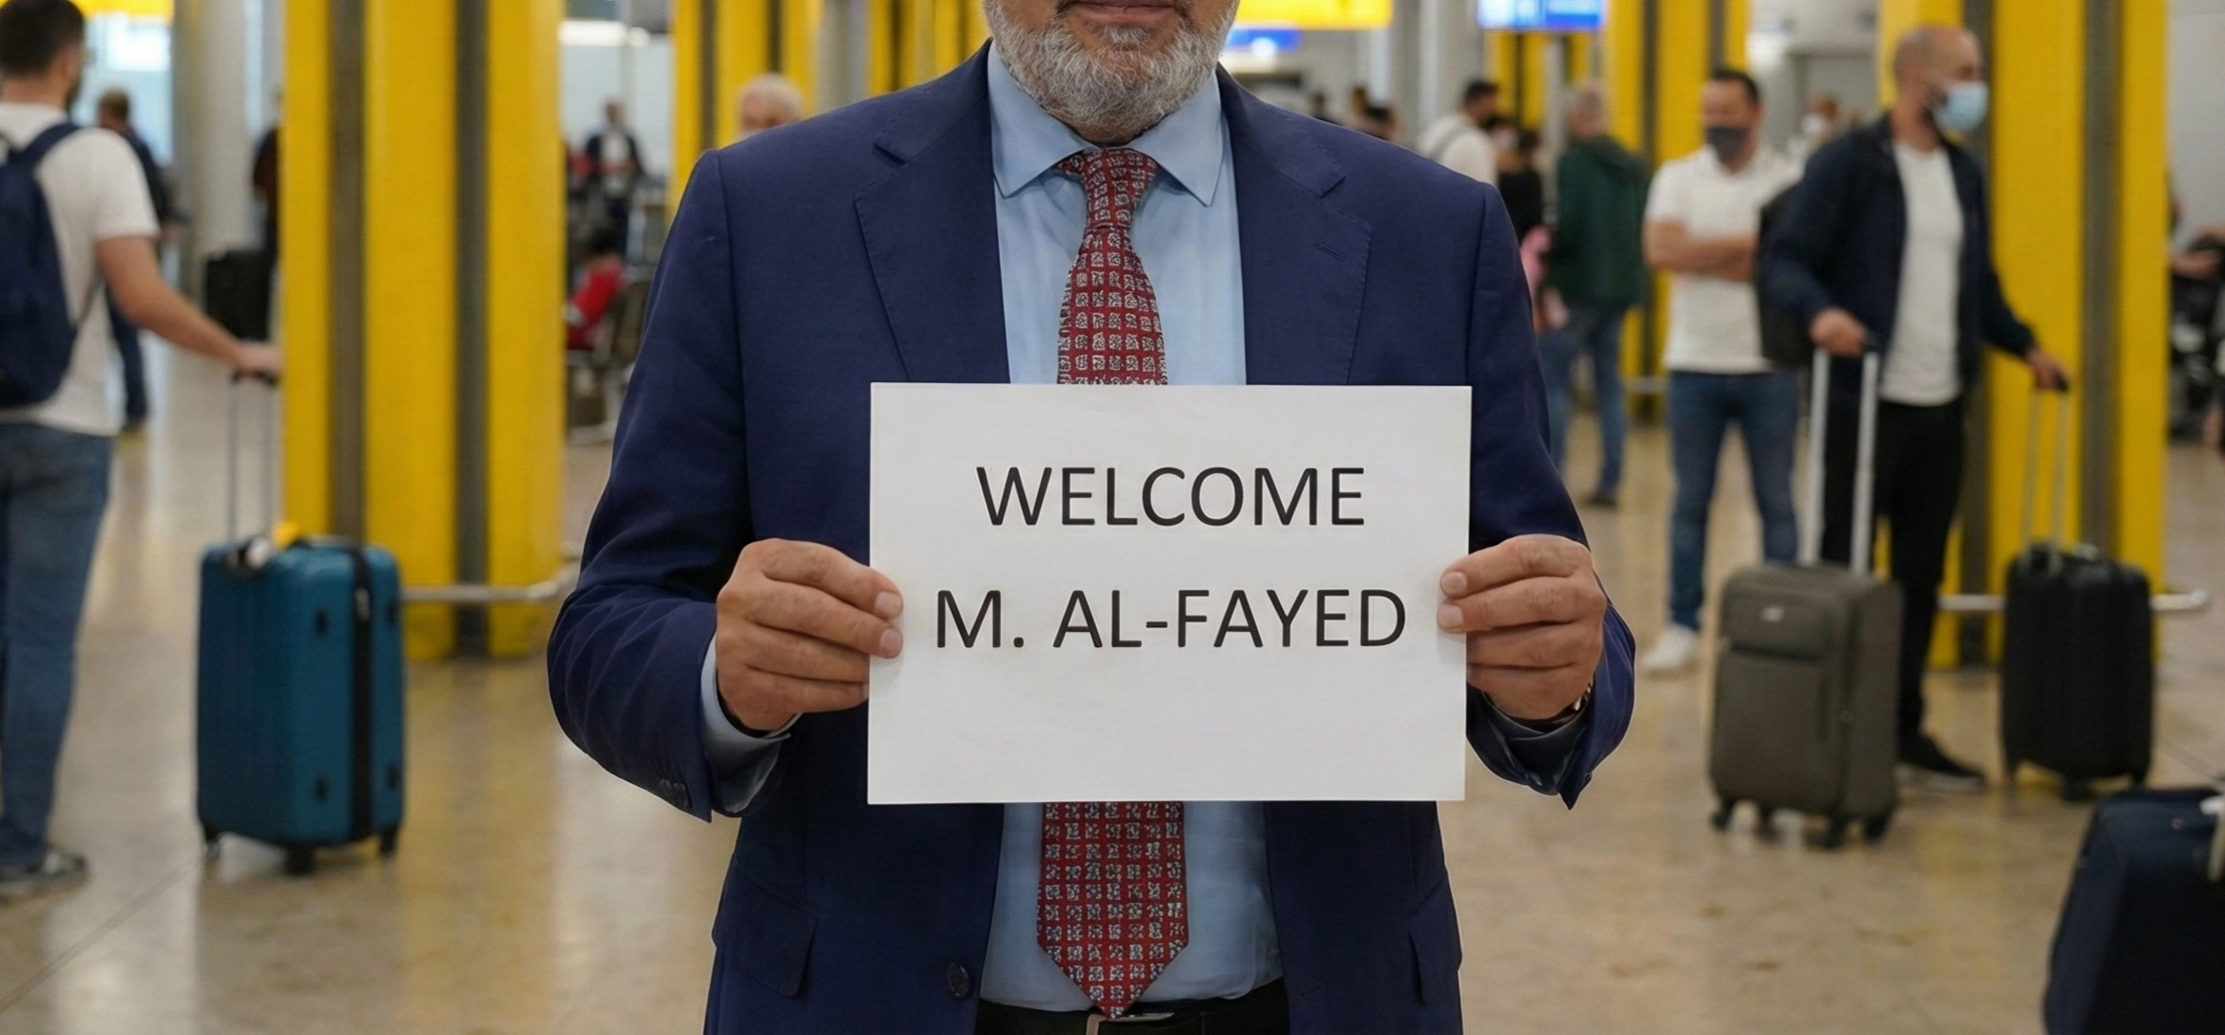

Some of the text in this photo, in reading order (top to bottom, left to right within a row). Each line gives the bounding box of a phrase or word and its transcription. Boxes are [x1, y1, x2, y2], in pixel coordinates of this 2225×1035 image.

[975, 466, 1365, 527] WELCOME
[936, 589, 1407, 649] M. AL-FAYED
